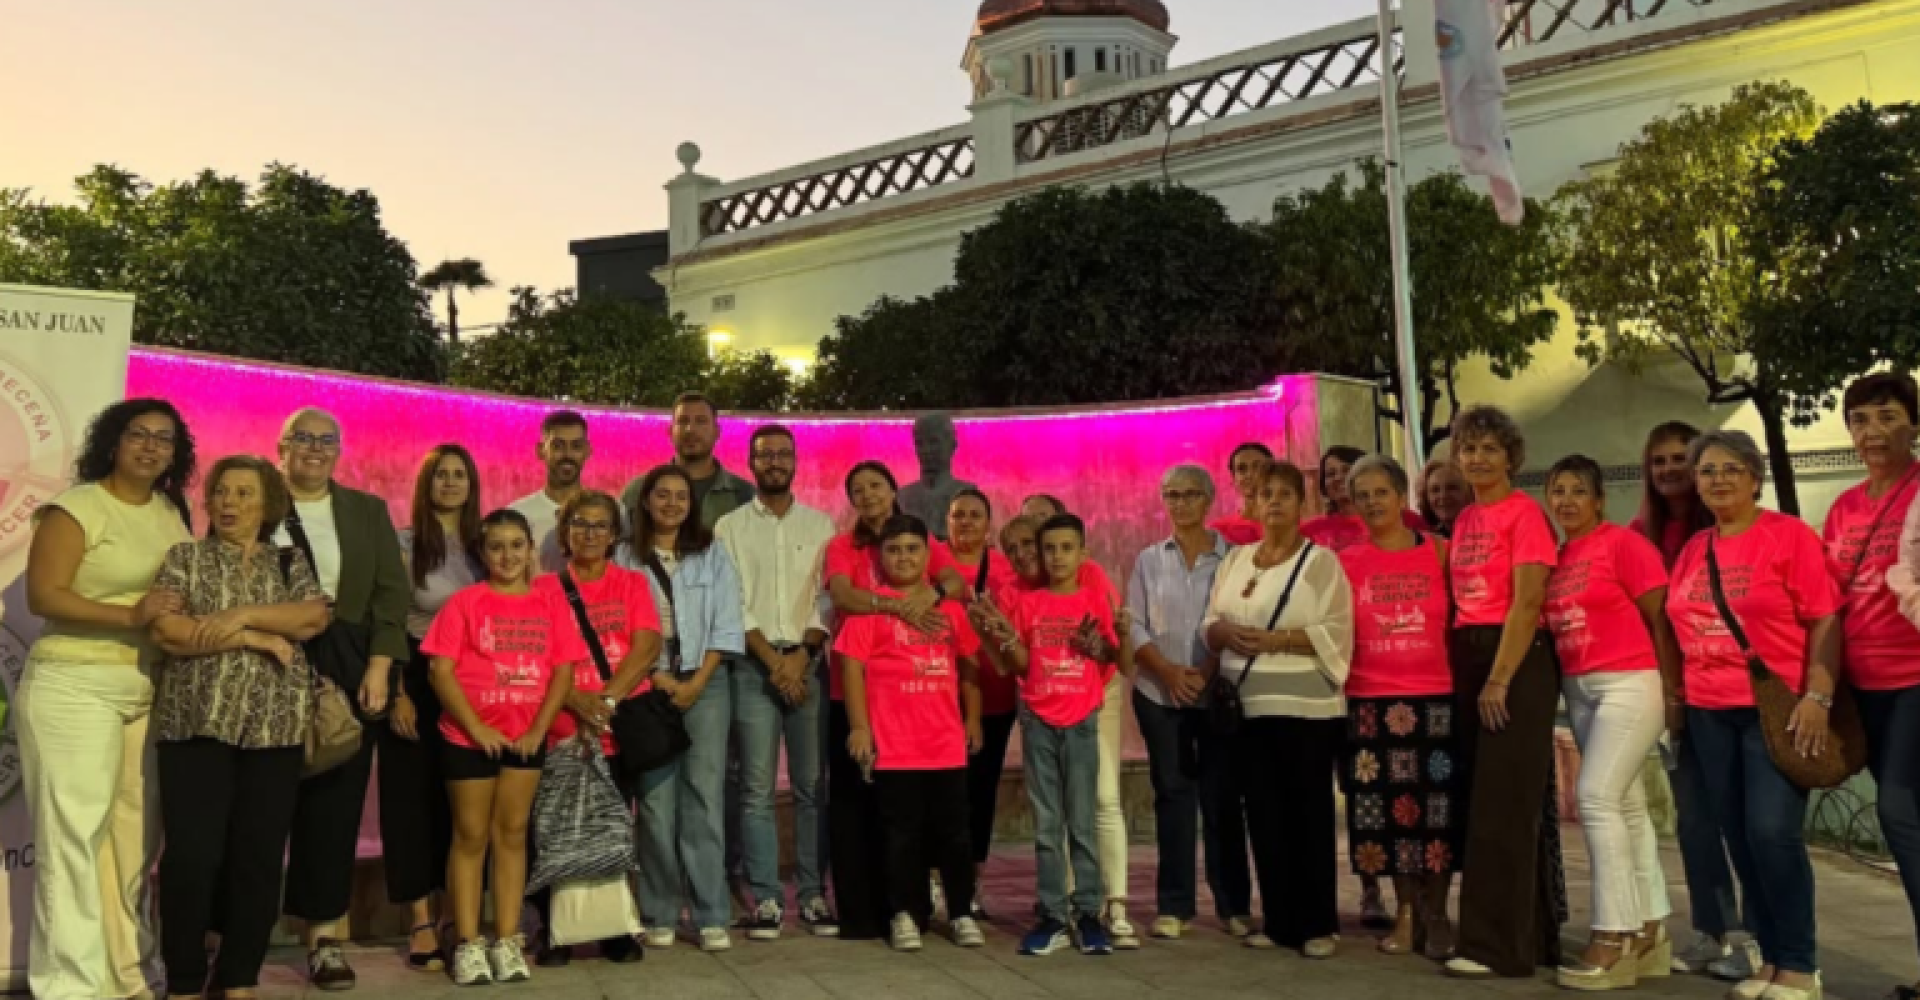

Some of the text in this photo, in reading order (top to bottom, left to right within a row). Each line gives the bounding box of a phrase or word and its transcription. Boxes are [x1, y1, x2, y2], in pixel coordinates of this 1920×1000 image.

[0, 310, 106, 336] SAN JUAN
[0, 494, 40, 541] CER
